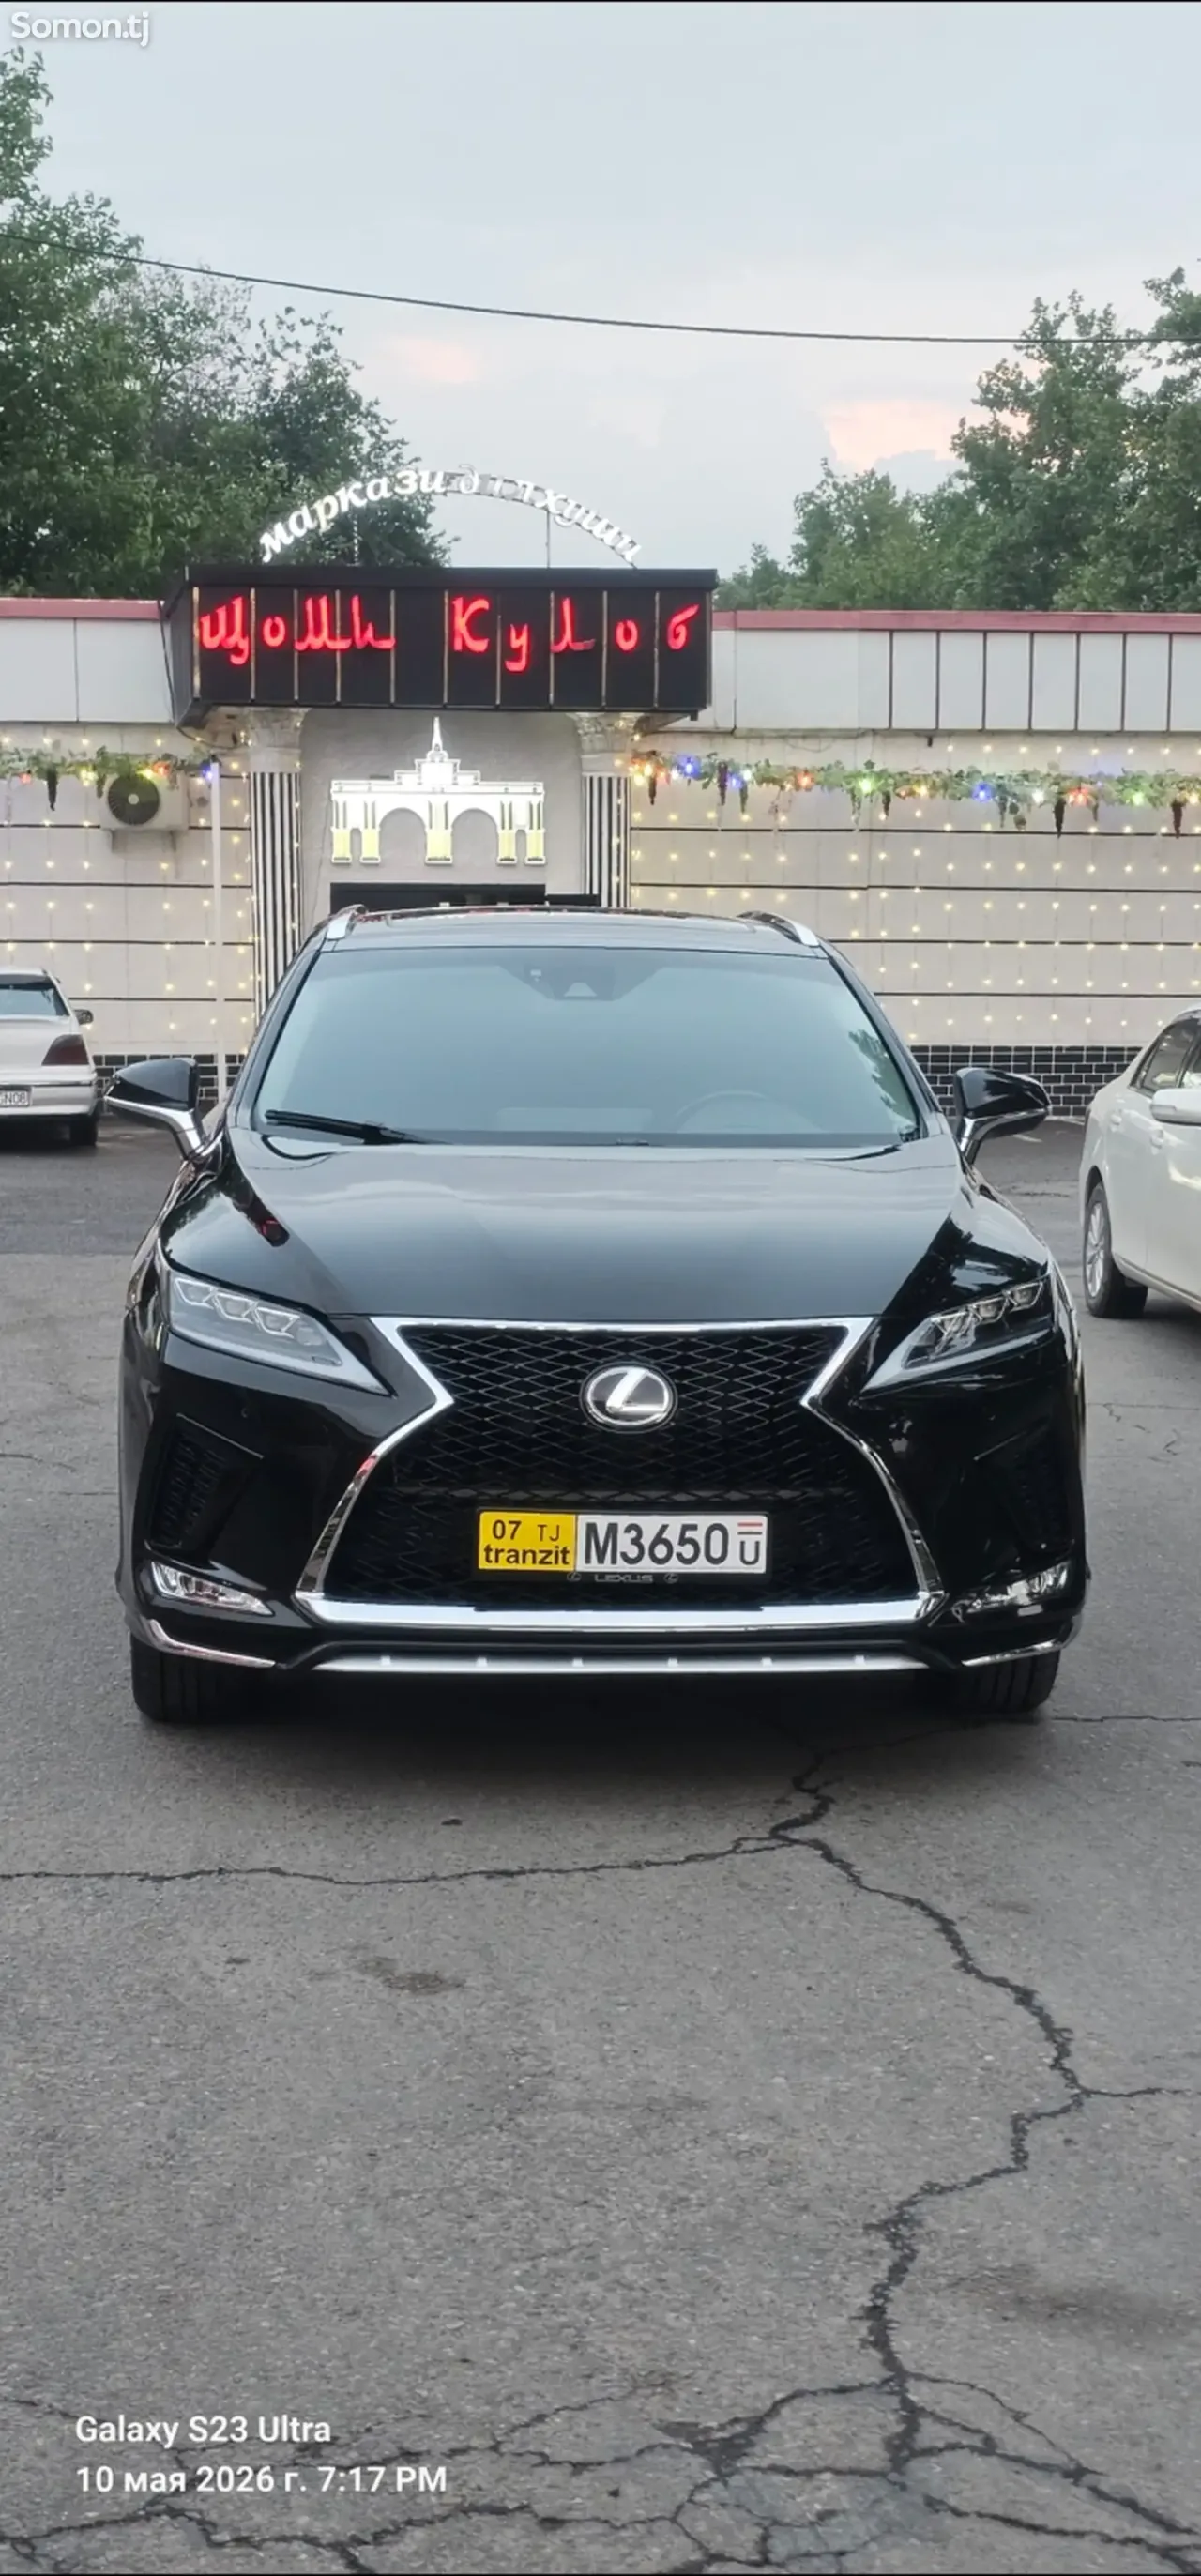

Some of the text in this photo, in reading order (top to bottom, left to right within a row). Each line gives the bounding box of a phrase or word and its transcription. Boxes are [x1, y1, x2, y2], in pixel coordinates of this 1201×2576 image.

[259, 469, 447, 563] маркази
[451, 596, 700, 672] Кулоб
[492, 1519, 560, 1542] 07 TJ
[483, 1544, 570, 1566] tranzit
[584, 1521, 729, 1566] M3650
[738, 1540, 761, 1565] U
[594, 1574, 654, 1584] LEXUS
